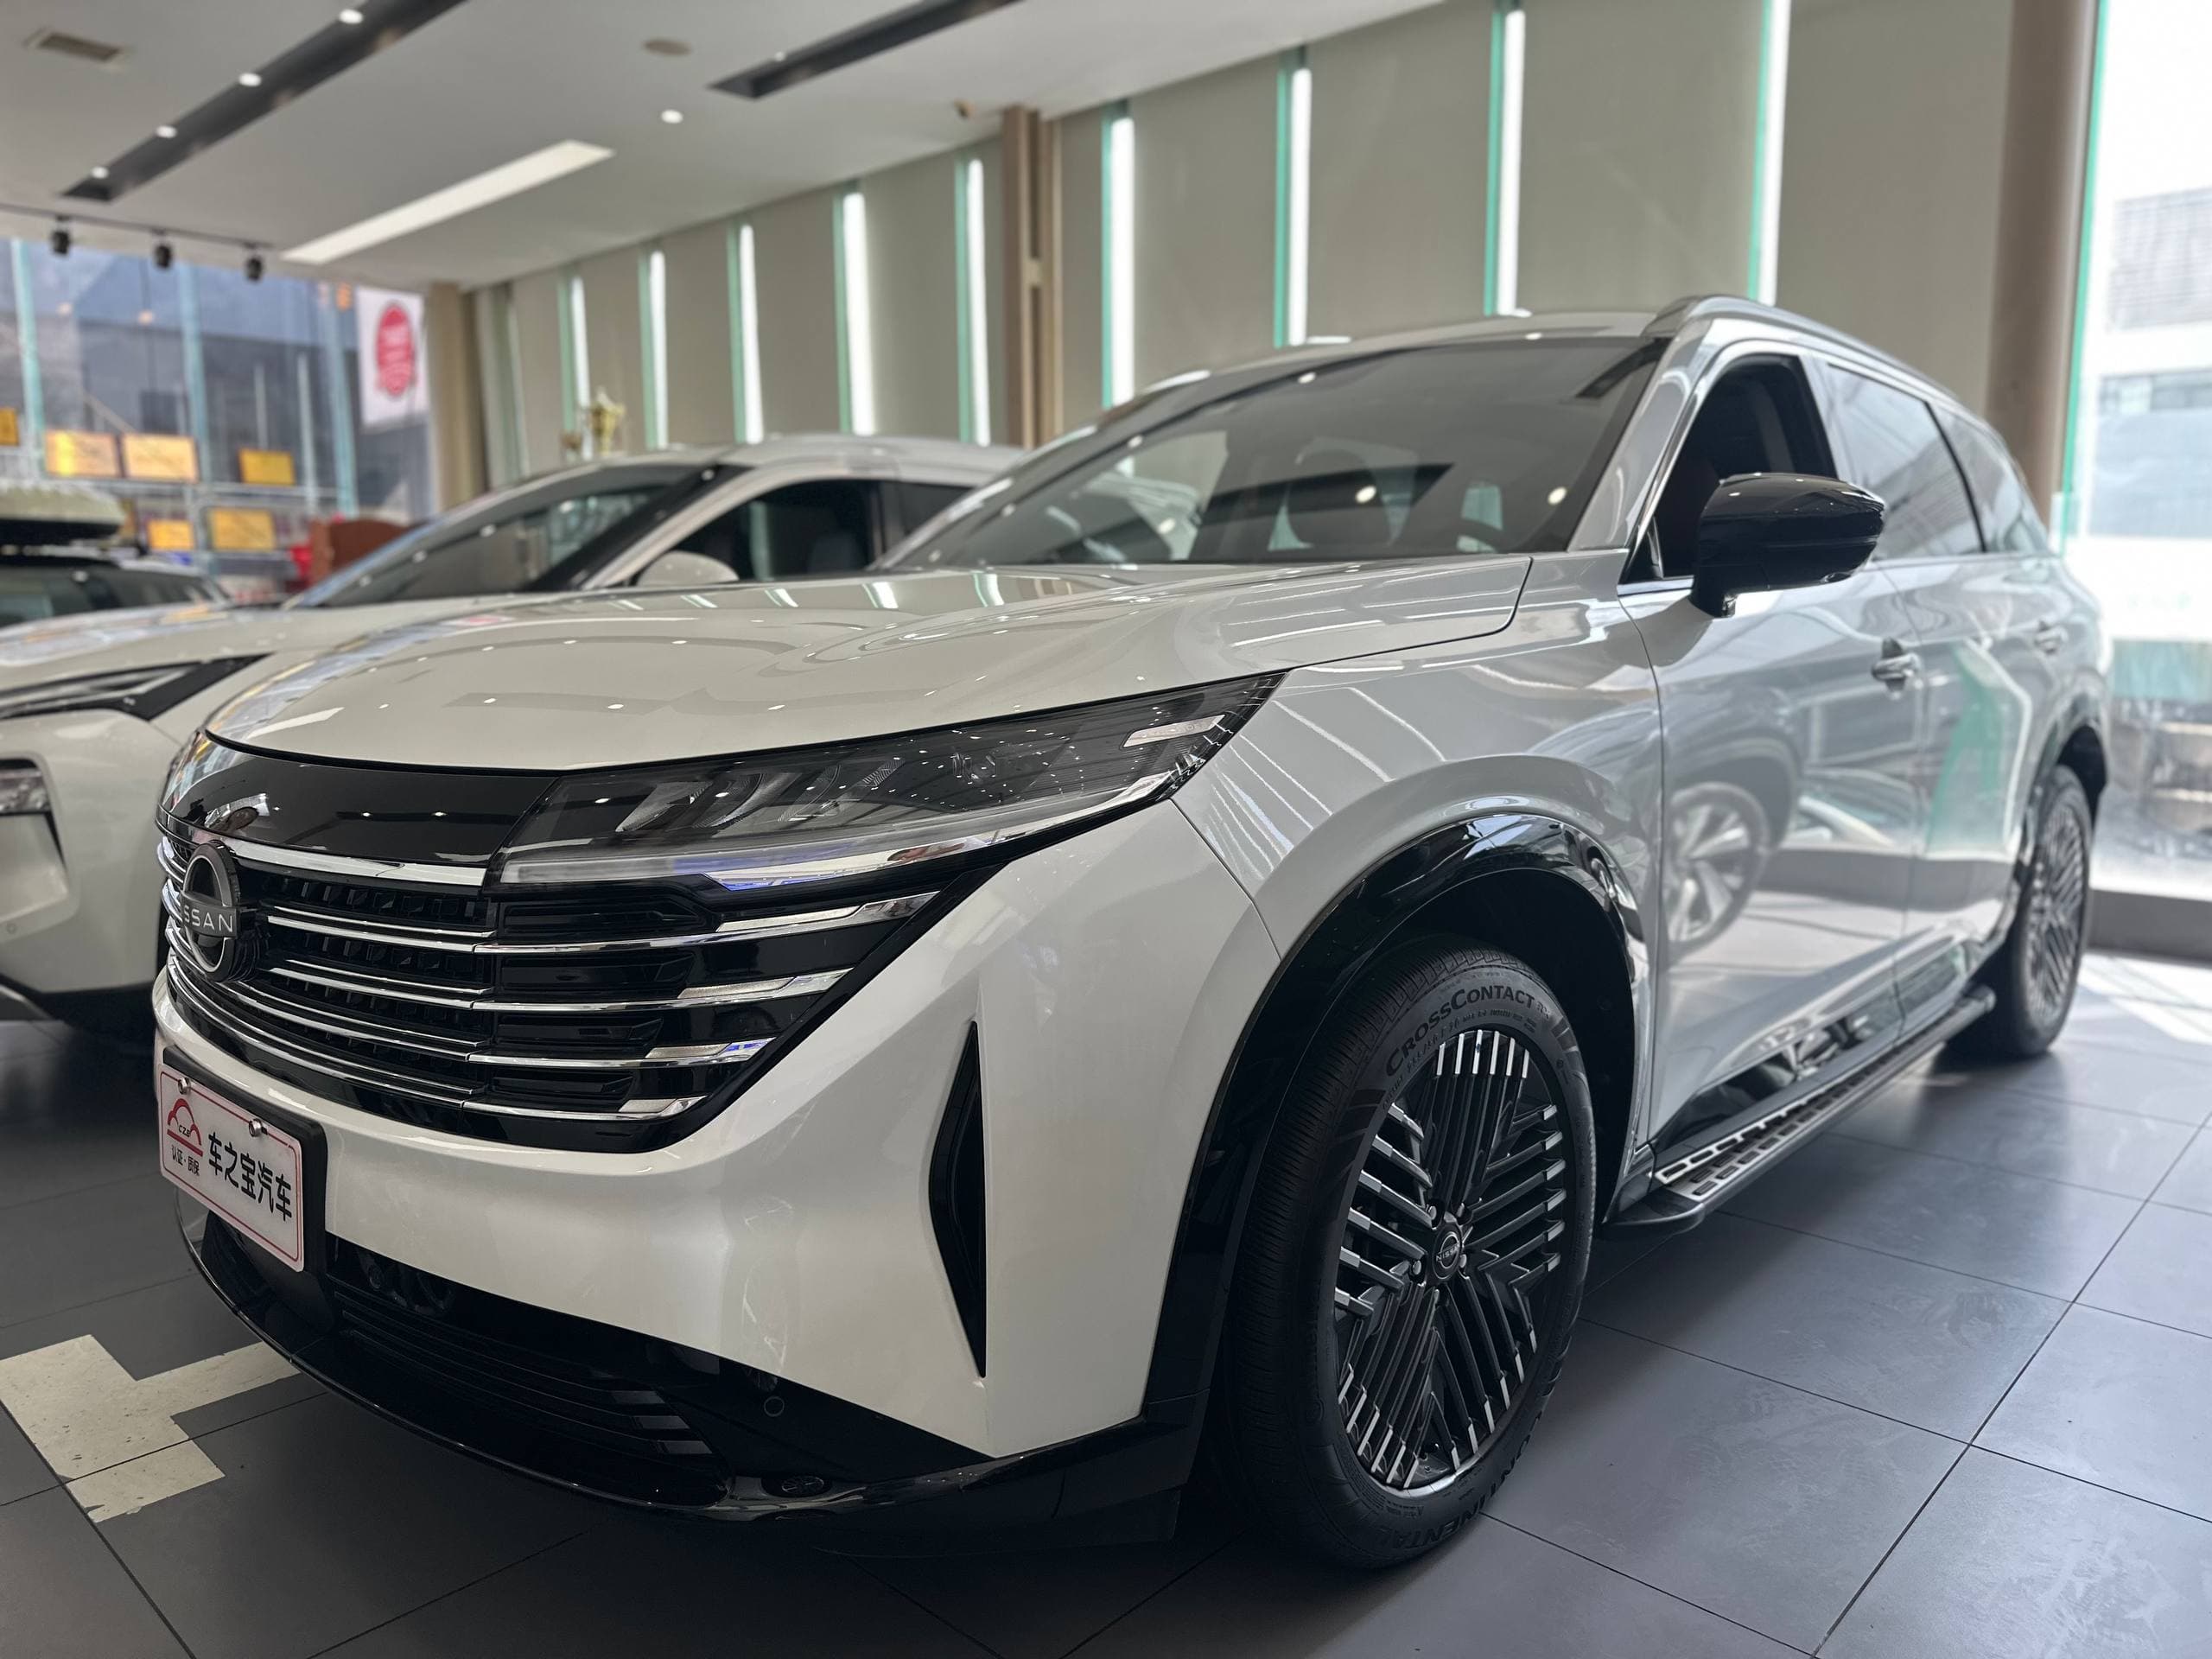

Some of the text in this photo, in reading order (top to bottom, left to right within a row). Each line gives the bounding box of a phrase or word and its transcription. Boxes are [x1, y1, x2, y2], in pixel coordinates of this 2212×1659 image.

[182, 906, 233, 932] SSAN
[208, 1131, 292, 1222] 车之宝汽车
